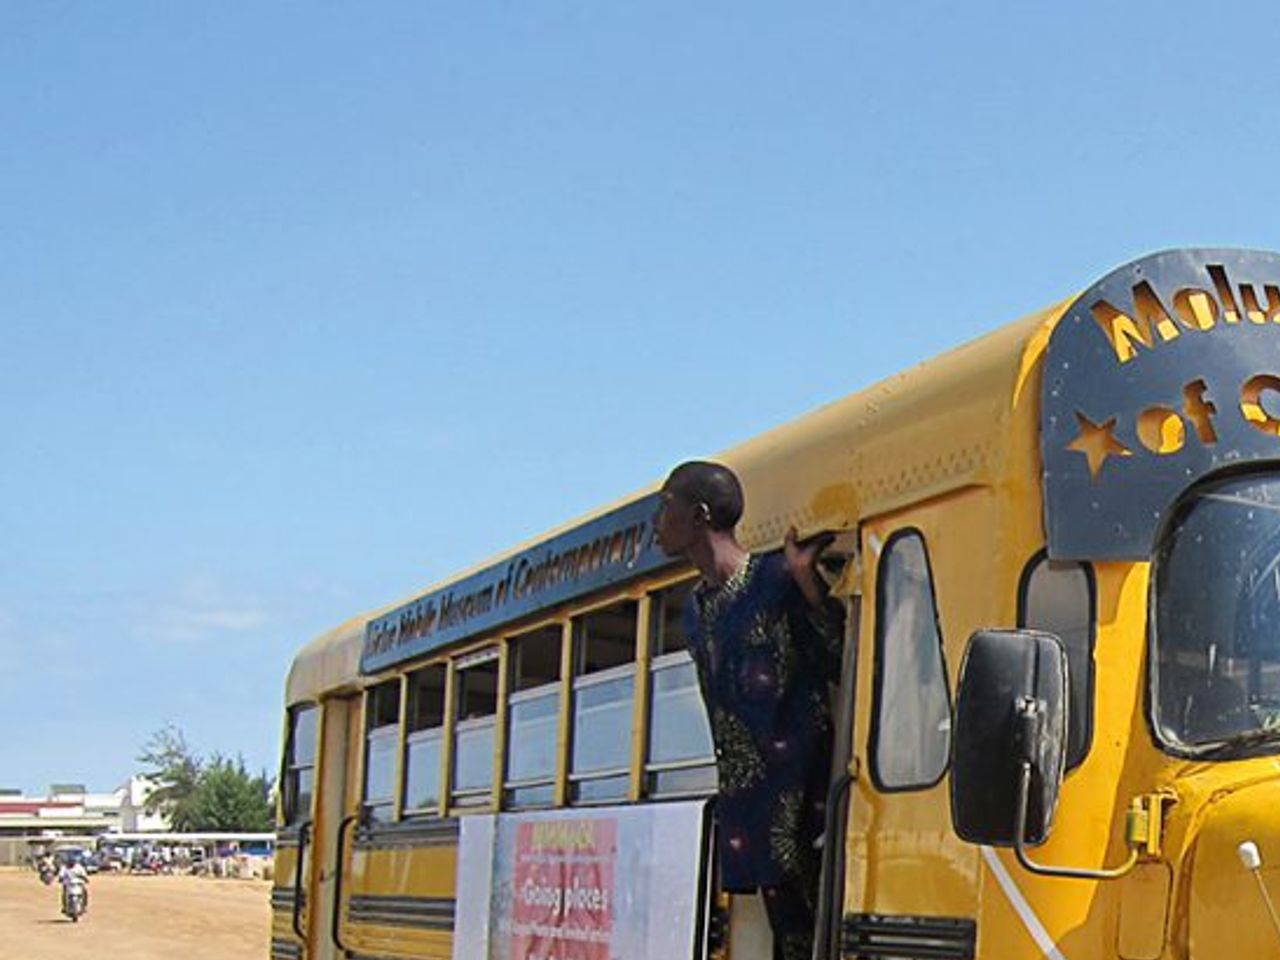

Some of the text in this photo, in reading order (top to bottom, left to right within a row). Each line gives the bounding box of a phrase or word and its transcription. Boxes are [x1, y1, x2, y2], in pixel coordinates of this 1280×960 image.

[1136, 379, 1218, 455] of
[438, 583, 495, 630] Museum
[513, 521, 647, 600] Contemporary
[523, 876, 608, 916] Going places
